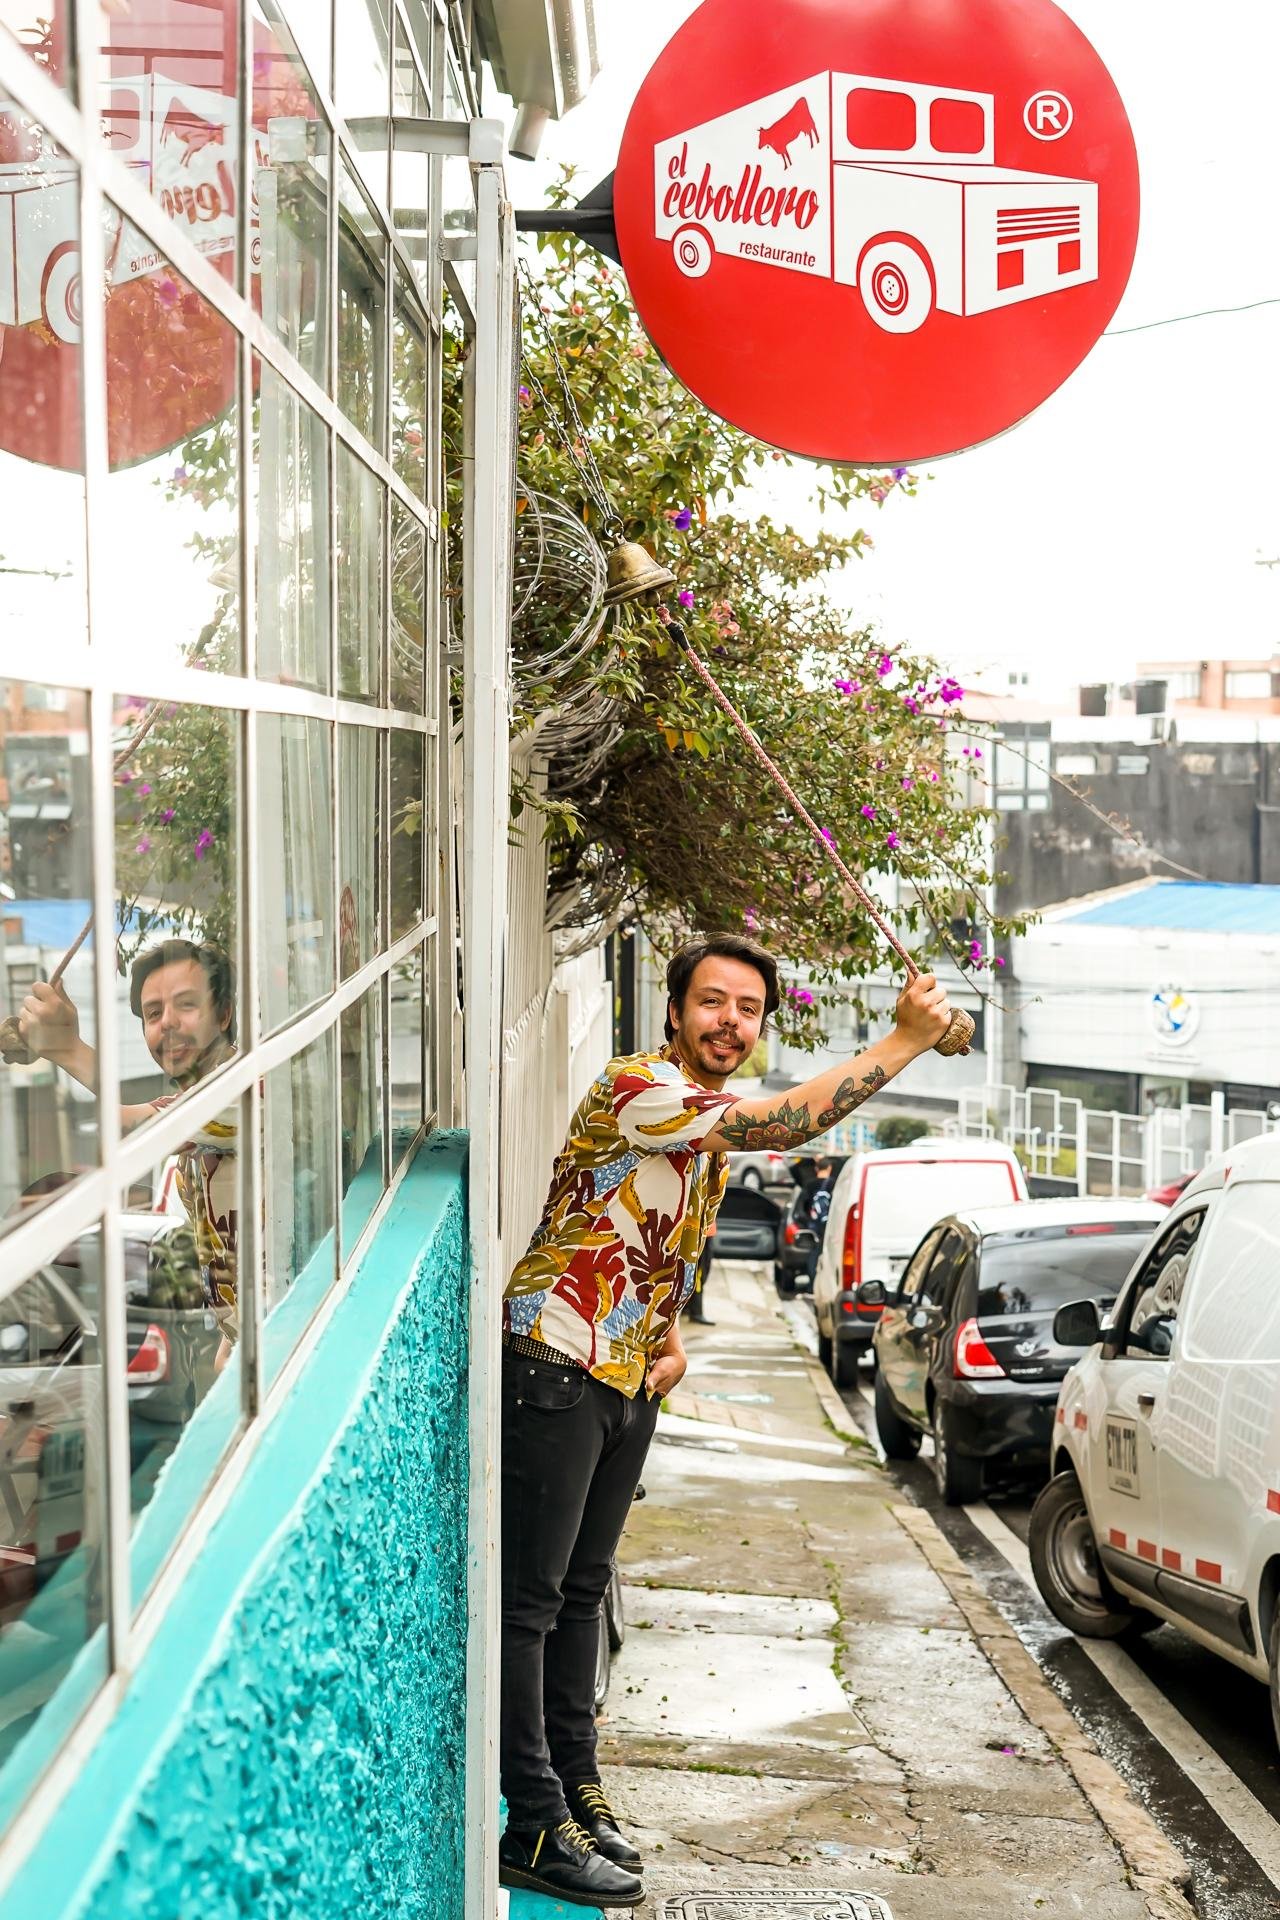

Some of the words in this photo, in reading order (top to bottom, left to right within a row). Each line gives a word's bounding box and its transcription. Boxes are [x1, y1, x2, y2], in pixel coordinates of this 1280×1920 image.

[668, 141, 688, 180] el
[663, 162, 819, 230] cebollero
[739, 240, 816, 268] restaurante
